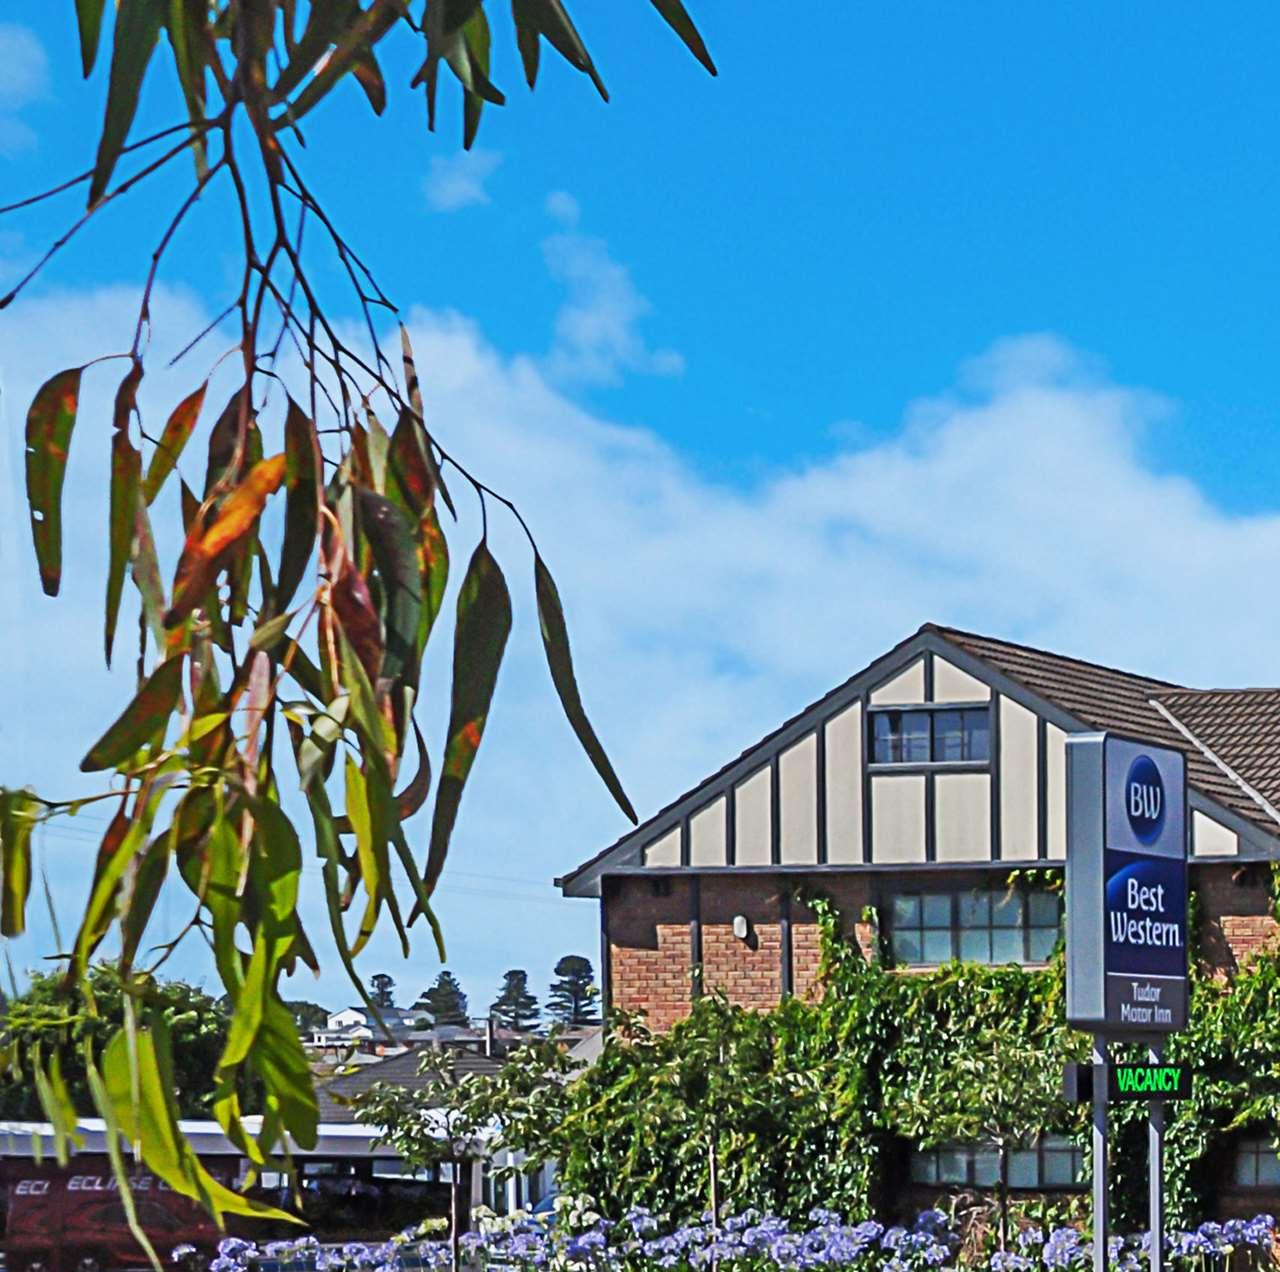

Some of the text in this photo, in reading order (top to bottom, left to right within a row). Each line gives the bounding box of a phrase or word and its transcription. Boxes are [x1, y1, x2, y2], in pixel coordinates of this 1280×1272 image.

[1130, 781, 1161, 820] BW
[1127, 878, 1165, 913] Best
[1110, 911, 1180, 947] Western
[1131, 982, 1161, 1002] Tudor
[1121, 1003, 1173, 1024] Motor Inn
[1116, 1068, 1181, 1093] VACANCY
